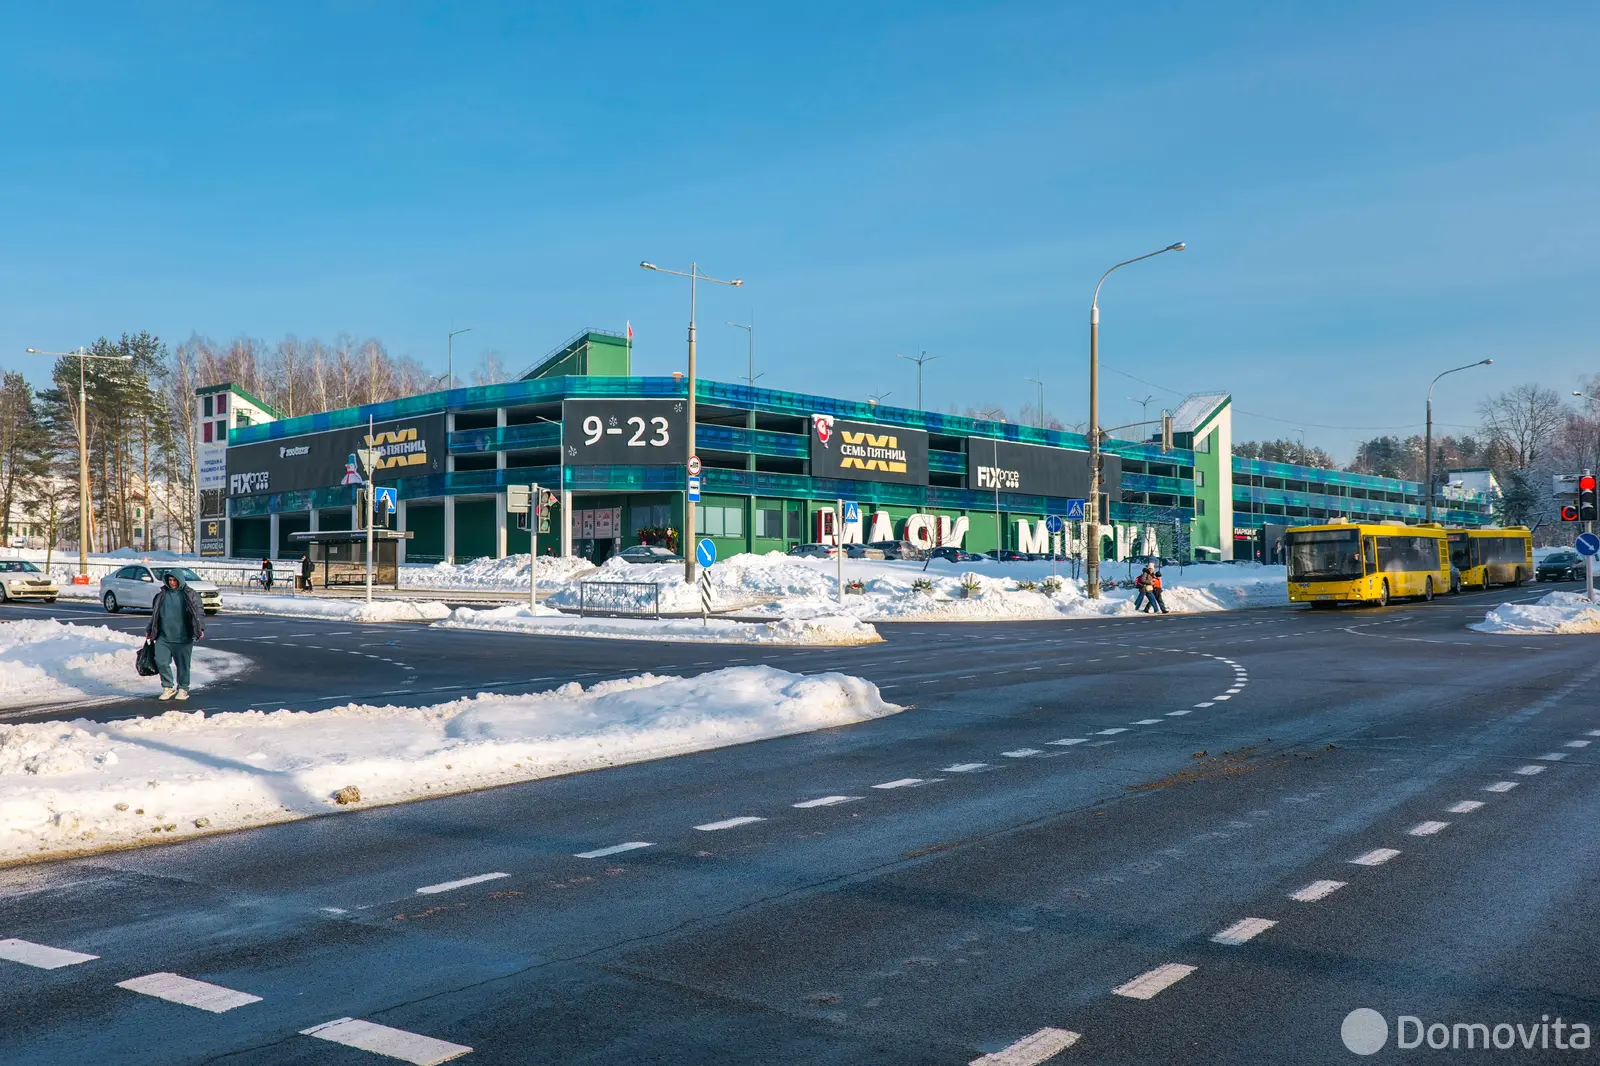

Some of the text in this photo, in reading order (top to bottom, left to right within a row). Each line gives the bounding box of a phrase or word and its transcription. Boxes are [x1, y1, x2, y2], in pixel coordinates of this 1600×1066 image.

[583, 416, 669, 446] 9-23
[387, 440, 426, 457] ПЯТНИЦ
[841, 444, 906, 462] СЕМЬ ПЯТНИЦ
[230, 471, 269, 495] FIX price
[977, 466, 1019, 488] FIX price
